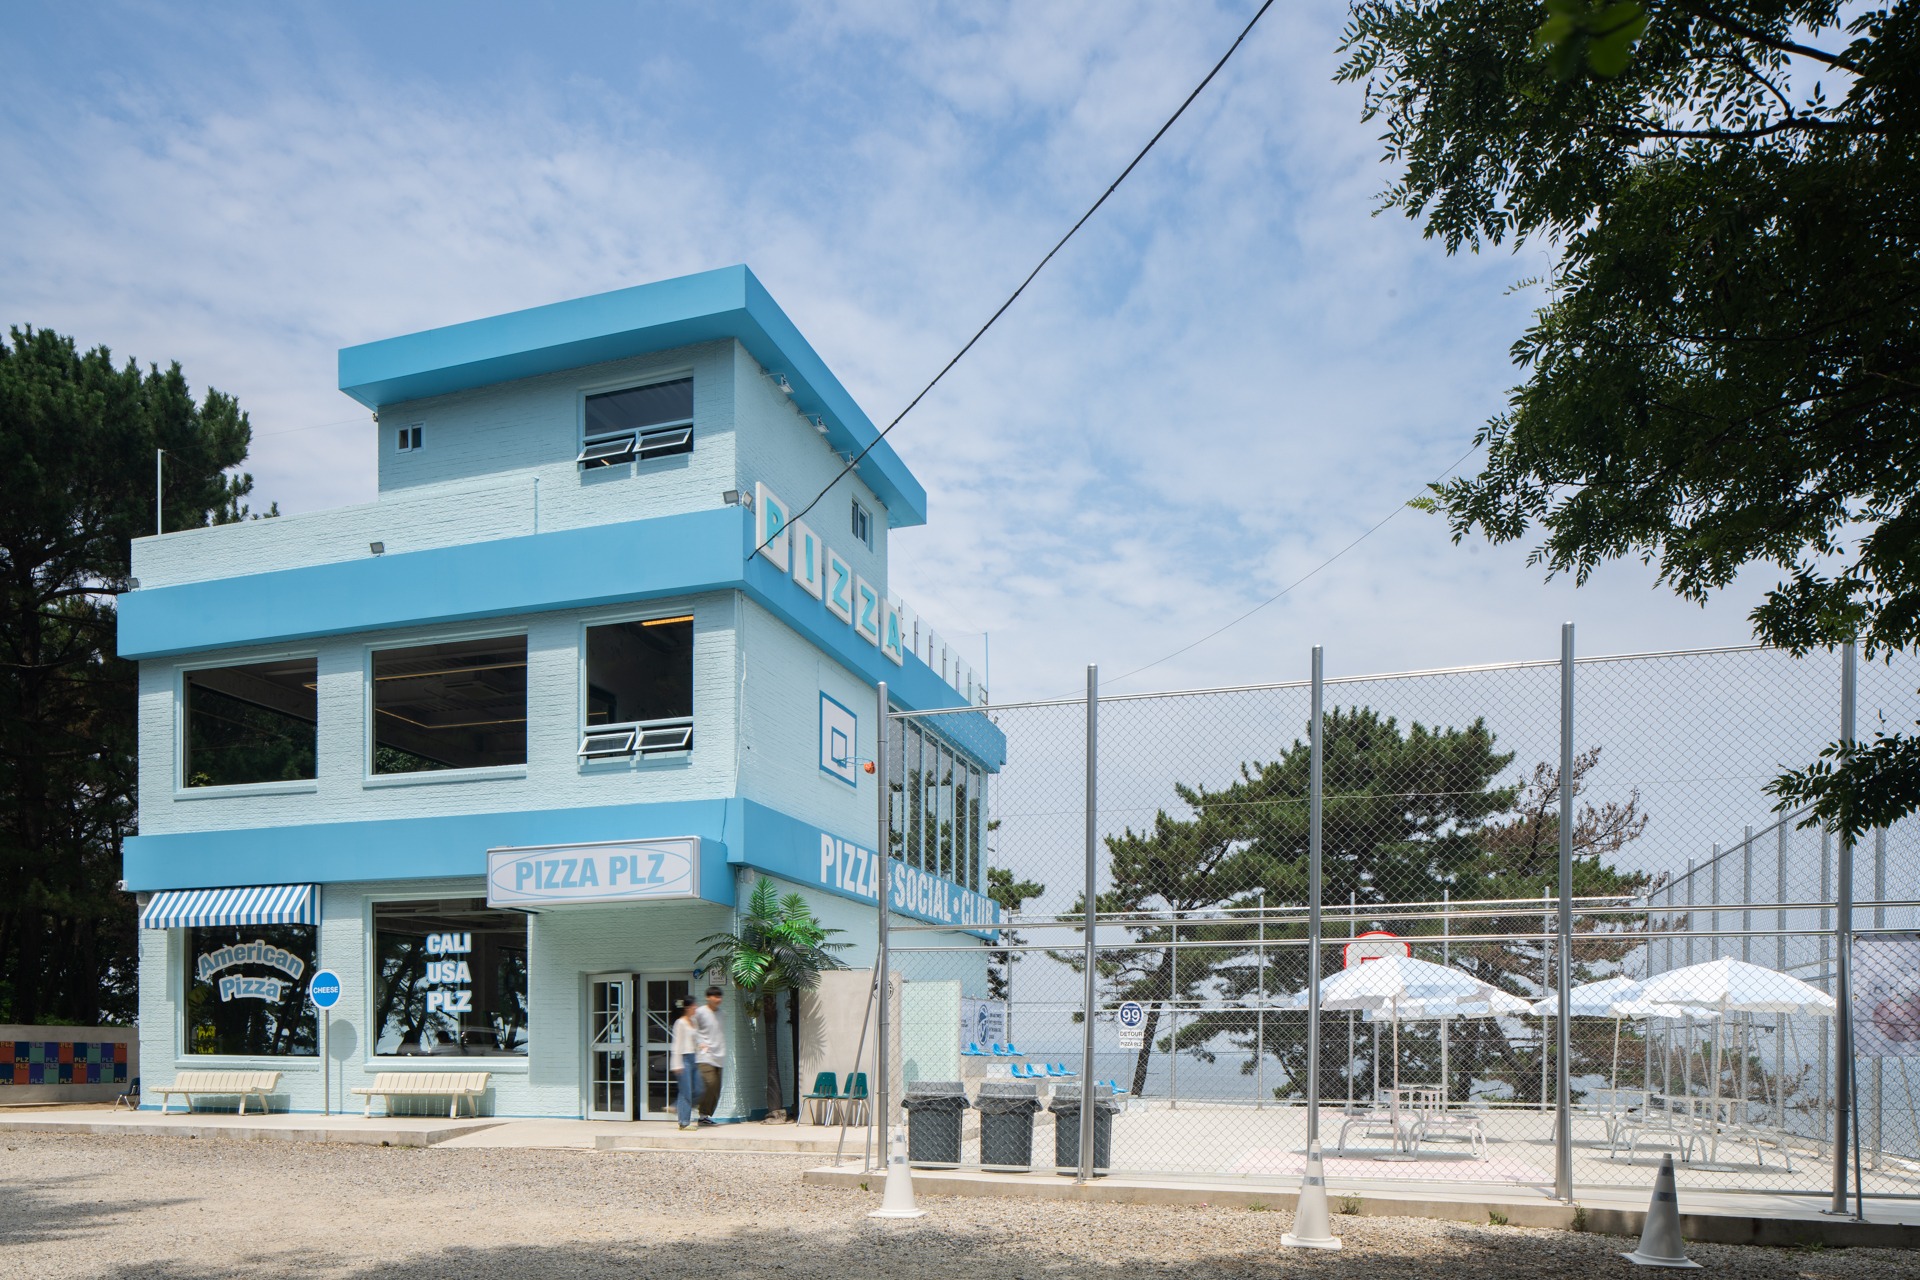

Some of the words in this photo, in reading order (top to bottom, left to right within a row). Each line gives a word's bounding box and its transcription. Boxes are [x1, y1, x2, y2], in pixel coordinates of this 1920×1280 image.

[764, 494, 902, 659] PIZZA
[515, 857, 600, 891] PIZZA
[609, 853, 665, 886] PLZ
[820, 833, 880, 901] PIZZA
[894, 863, 952, 923] SOCIAL
[961, 889, 994, 935] CLUB
[426, 932, 472, 955] CALI
[198, 939, 305, 980] American
[426, 960, 472, 984] USA
[219, 973, 282, 1003] Pizza
[313, 985, 339, 994] CHEESE
[426, 989, 473, 1013] PLZ
[1122, 1009, 1140, 1022] 99
